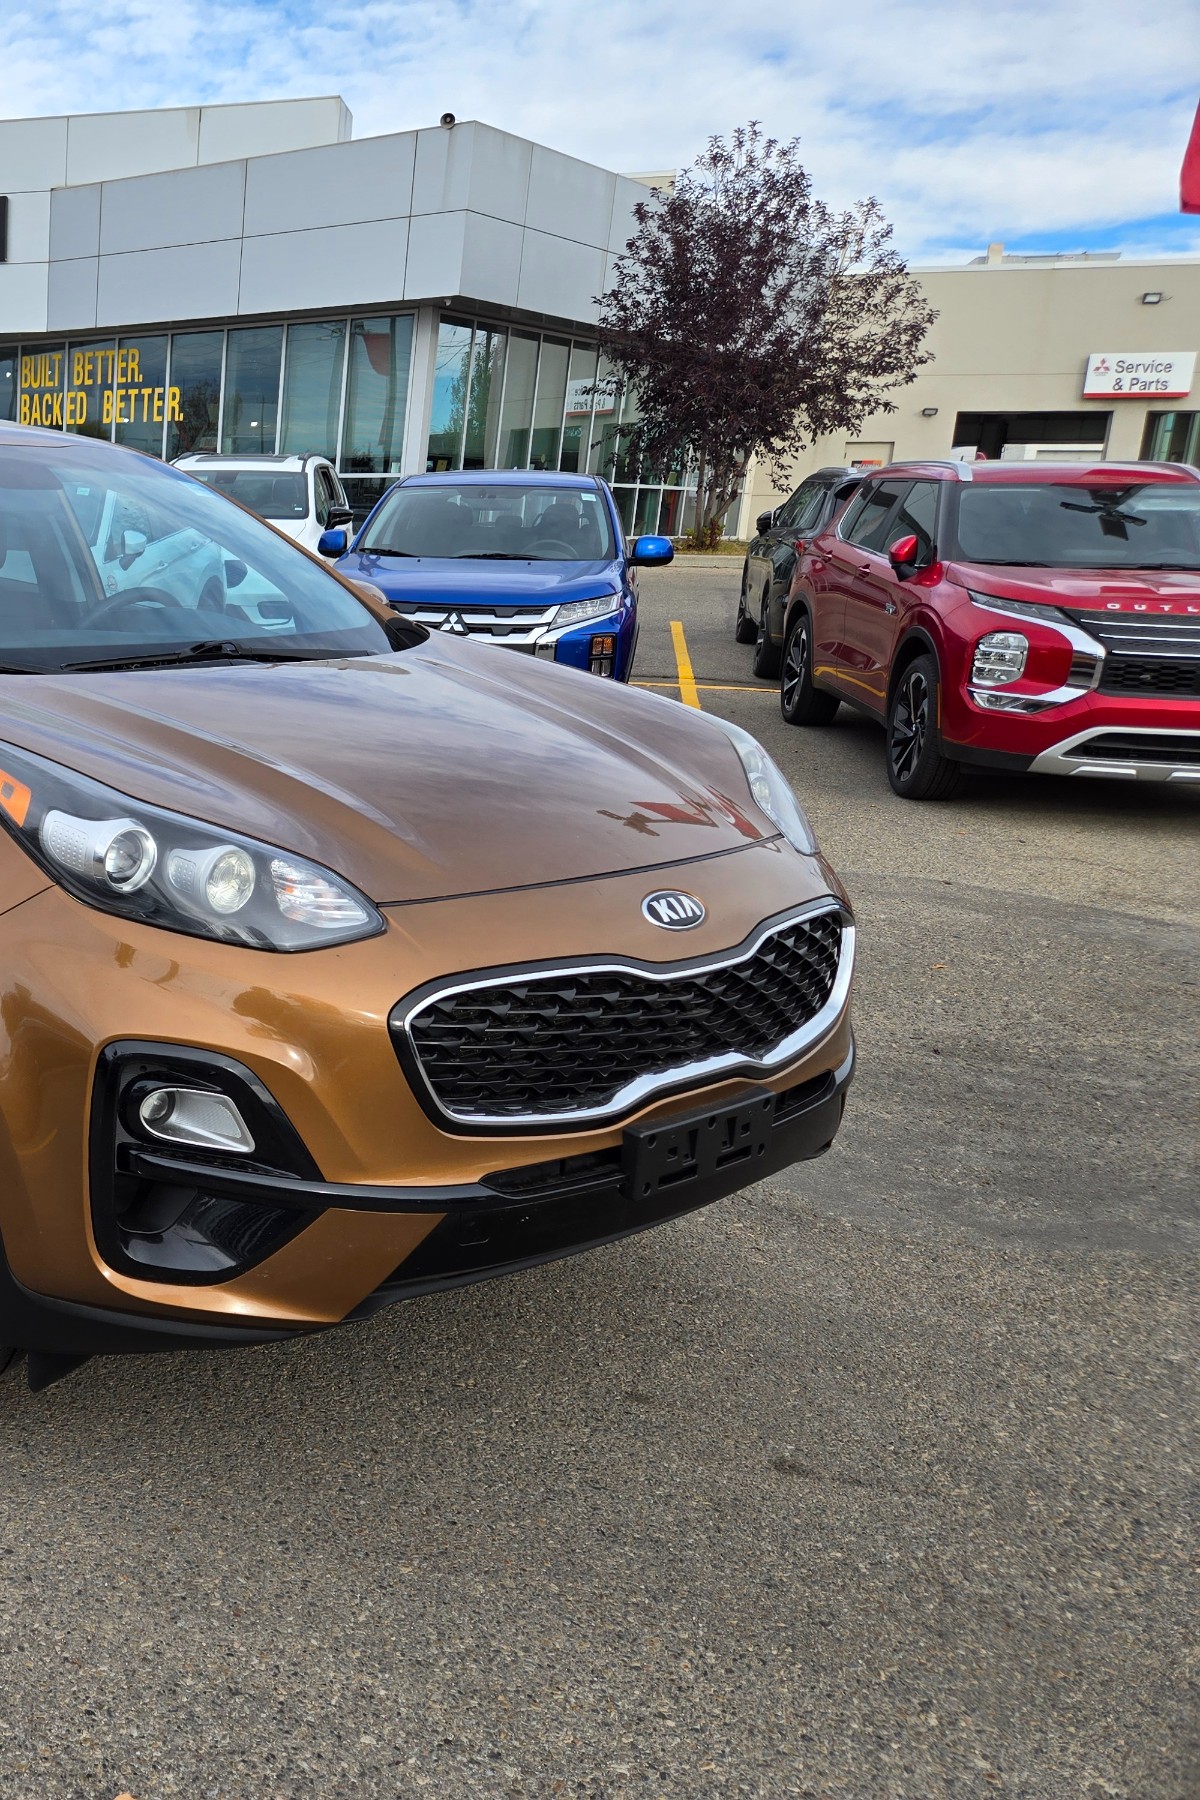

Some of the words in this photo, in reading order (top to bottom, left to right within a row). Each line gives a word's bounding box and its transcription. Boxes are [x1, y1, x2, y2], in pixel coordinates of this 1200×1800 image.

[21, 353, 62, 389] BUILT
[73, 348, 143, 386] BETTER.
[1114, 359, 1173, 374] Service
[1112, 377, 1123, 391] &
[1129, 377, 1169, 391] Parts
[20, 391, 87, 426] BACKED
[102, 387, 184, 424] BETTER.
[649, 895, 702, 923] KIA
